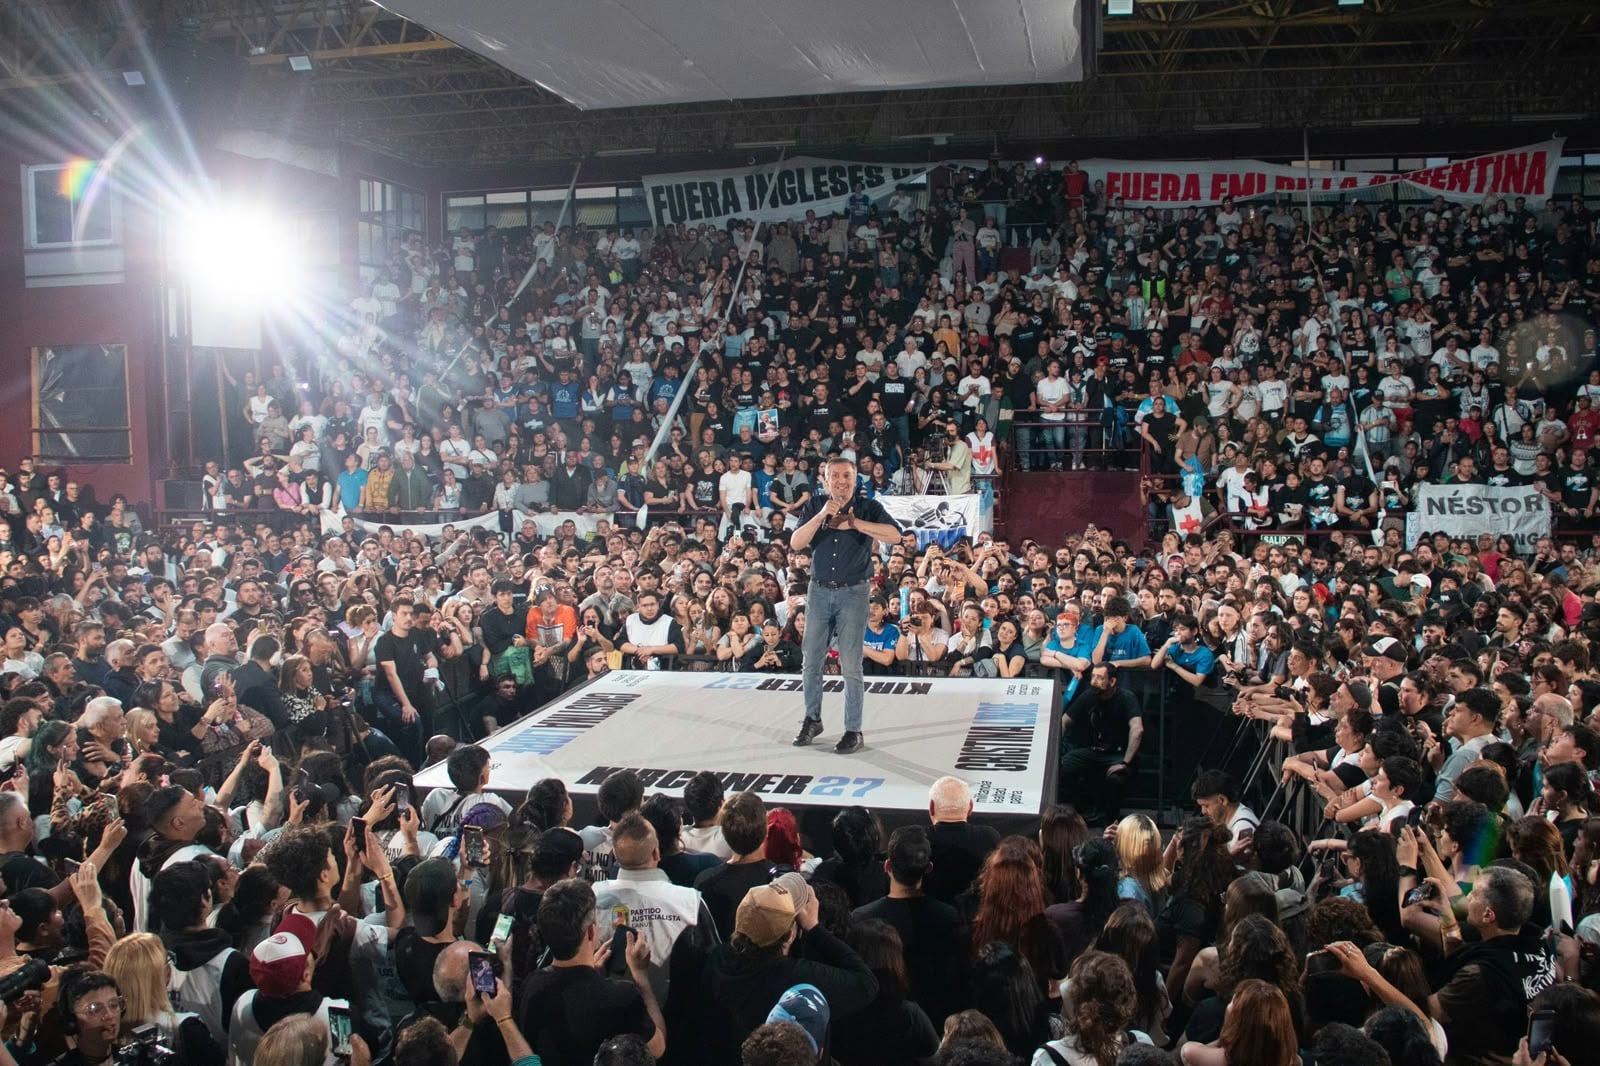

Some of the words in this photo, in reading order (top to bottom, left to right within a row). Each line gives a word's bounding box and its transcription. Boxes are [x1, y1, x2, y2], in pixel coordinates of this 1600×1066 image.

[651, 178, 742, 226] FUERA
[744, 165, 886, 212] INGLESES
[1106, 172, 1202, 201] FUERA
[1210, 172, 1266, 201] FMI
[1426, 490, 1544, 516] NÉSTOR
[1262, 535, 1296, 546] SALID
[703, 676, 759, 690] 27
[530, 692, 642, 728] CRISTINA
[954, 726, 1035, 771] CRISTINA
[809, 776, 885, 798] 27
[631, 908, 661, 916] PARTIDO
